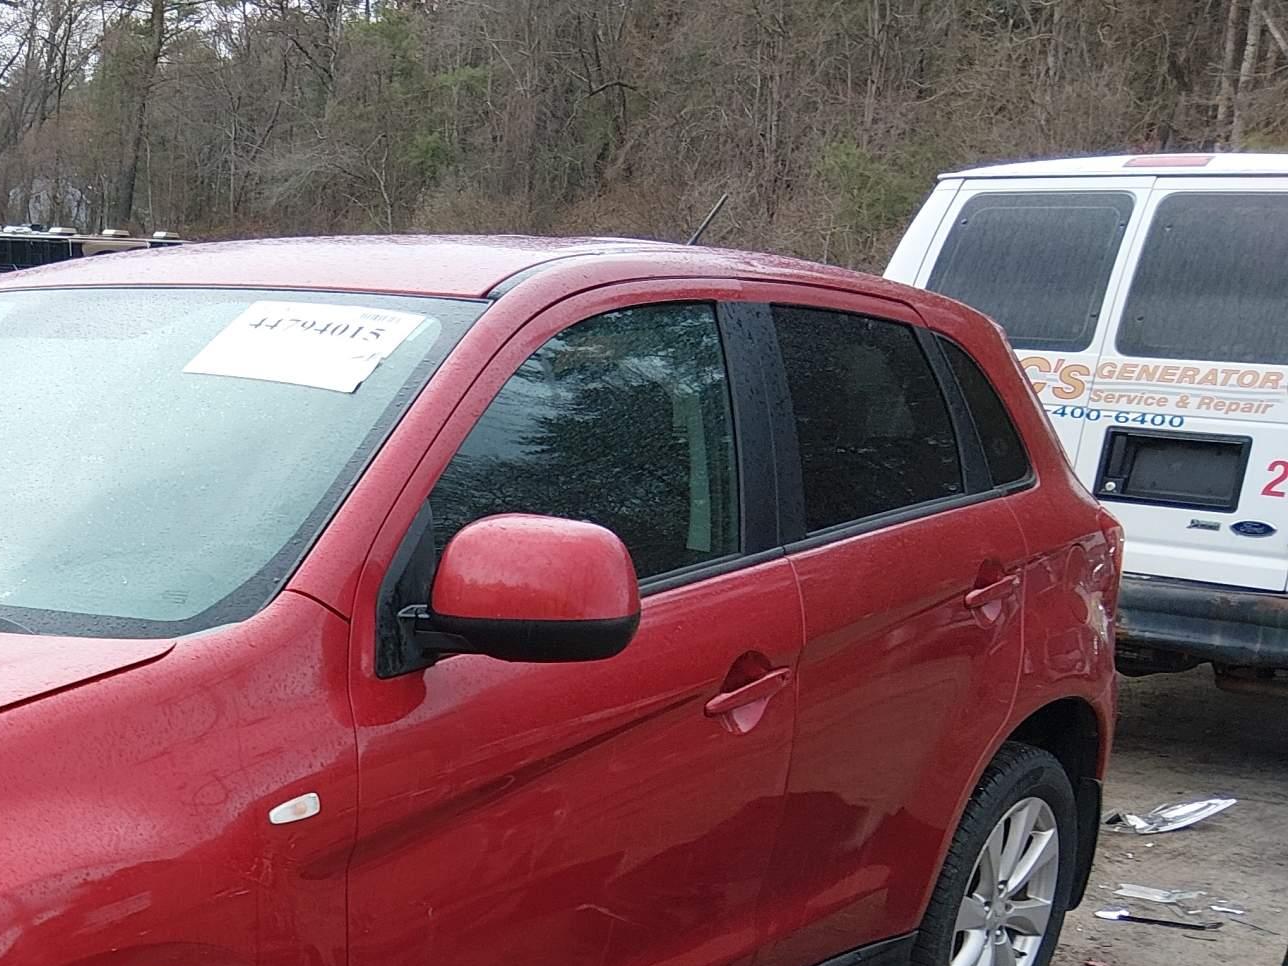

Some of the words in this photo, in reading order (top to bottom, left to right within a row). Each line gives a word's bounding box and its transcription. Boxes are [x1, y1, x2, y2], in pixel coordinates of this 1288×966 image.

[1095, 362, 1285, 390] GENERATOR
[1089, 389, 1169, 407] Service
[1175, 395, 1190, 409] &
[1196, 396, 1275, 415] Repair
[1261, 460, 1288, 498] 2
